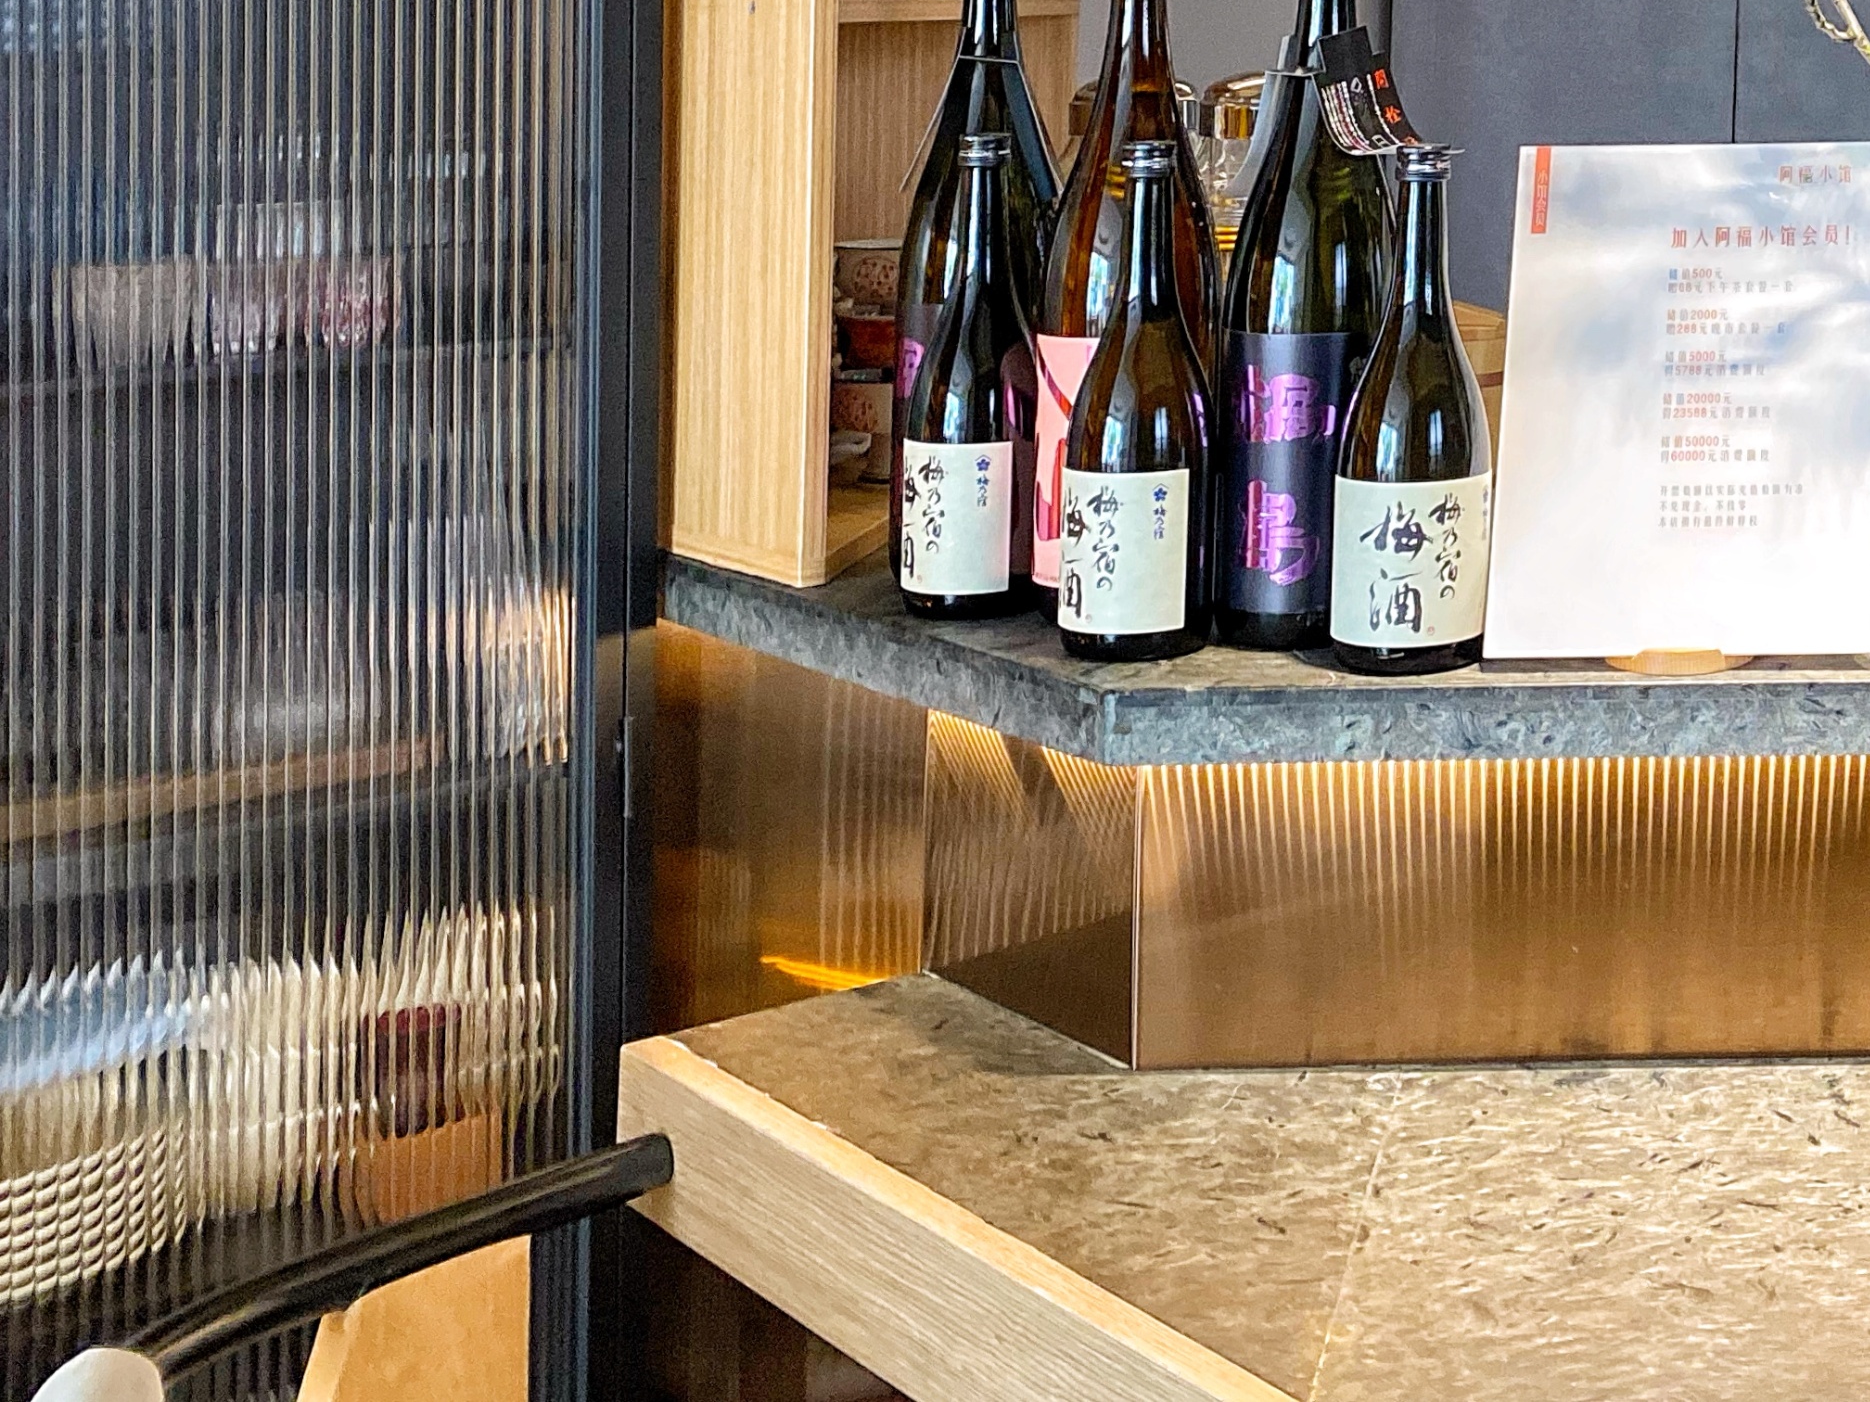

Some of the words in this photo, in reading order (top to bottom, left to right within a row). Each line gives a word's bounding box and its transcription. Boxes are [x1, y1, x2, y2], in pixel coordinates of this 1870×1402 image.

[1779, 165, 1852, 183] 阿福小馆
[1359, 501, 1434, 634] 梅酒
